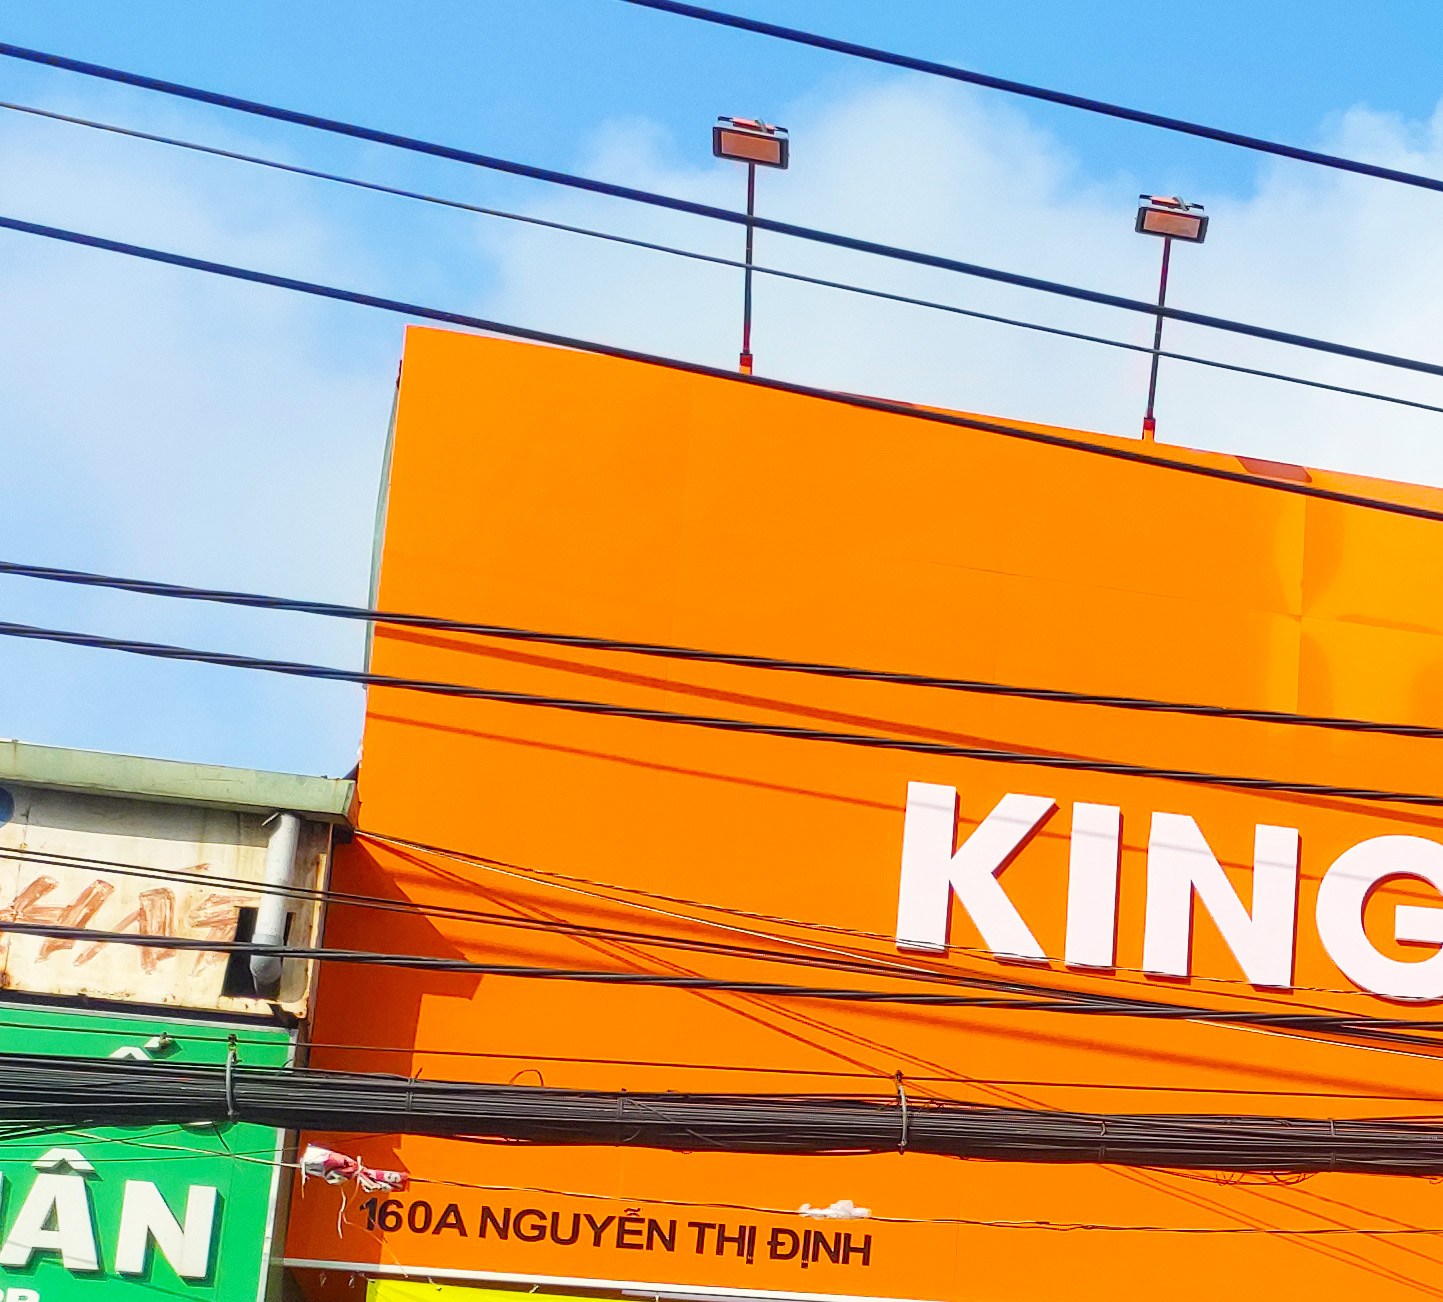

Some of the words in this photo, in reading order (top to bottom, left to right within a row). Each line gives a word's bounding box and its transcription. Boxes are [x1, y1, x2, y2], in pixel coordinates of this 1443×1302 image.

[360, 1197, 467, 1237] 160A
[479, 1206, 676, 1253] NGUYỄN
[688, 1221, 756, 1265] THỊ
[767, 1227, 873, 1268] ĐỊNH
